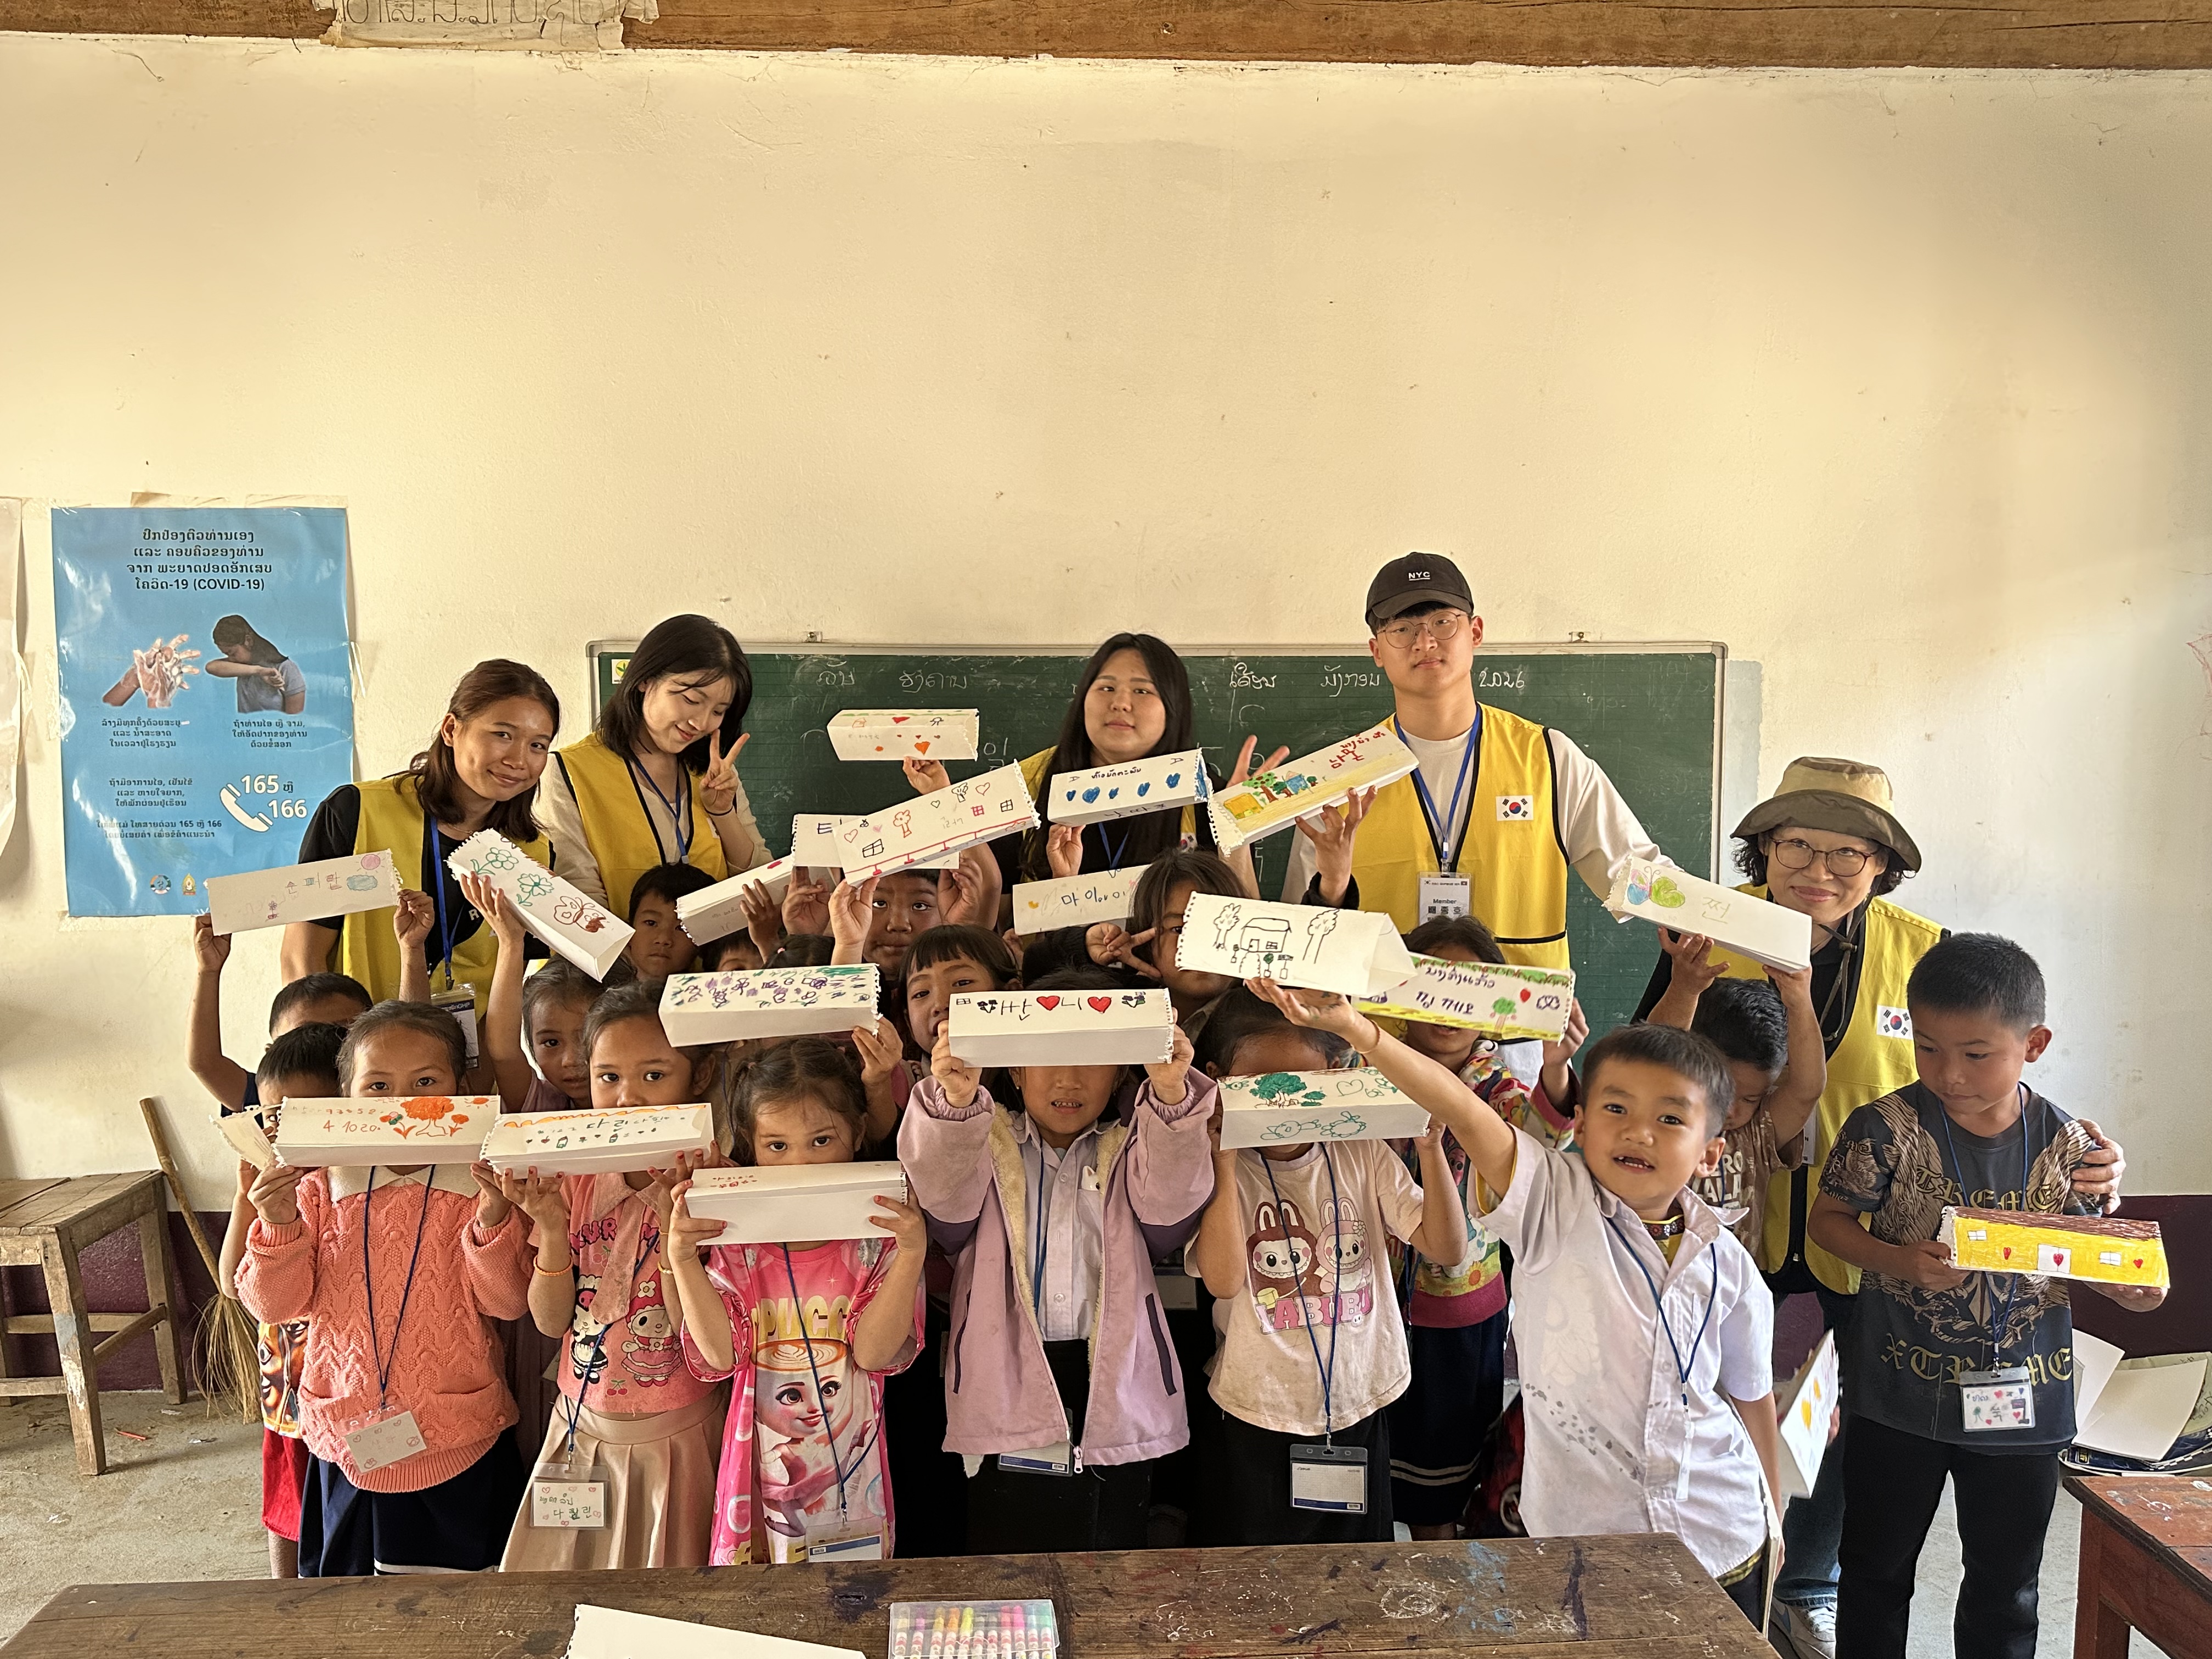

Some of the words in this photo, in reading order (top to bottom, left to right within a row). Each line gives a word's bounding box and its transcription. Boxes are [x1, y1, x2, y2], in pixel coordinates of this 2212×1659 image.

[143, 528, 254, 543] ປົກປ້ອງຕົວທ່ານເອງ
[134, 548, 161, 556] ແລະ
[167, 545, 264, 559] ຄອບຄົວຂອງທ່ານ
[127, 564, 152, 573] ຈາກ
[193, 578, 264, 591] (COVID-19)
[240, 774, 279, 794] 165
[268, 799, 308, 819] 166
